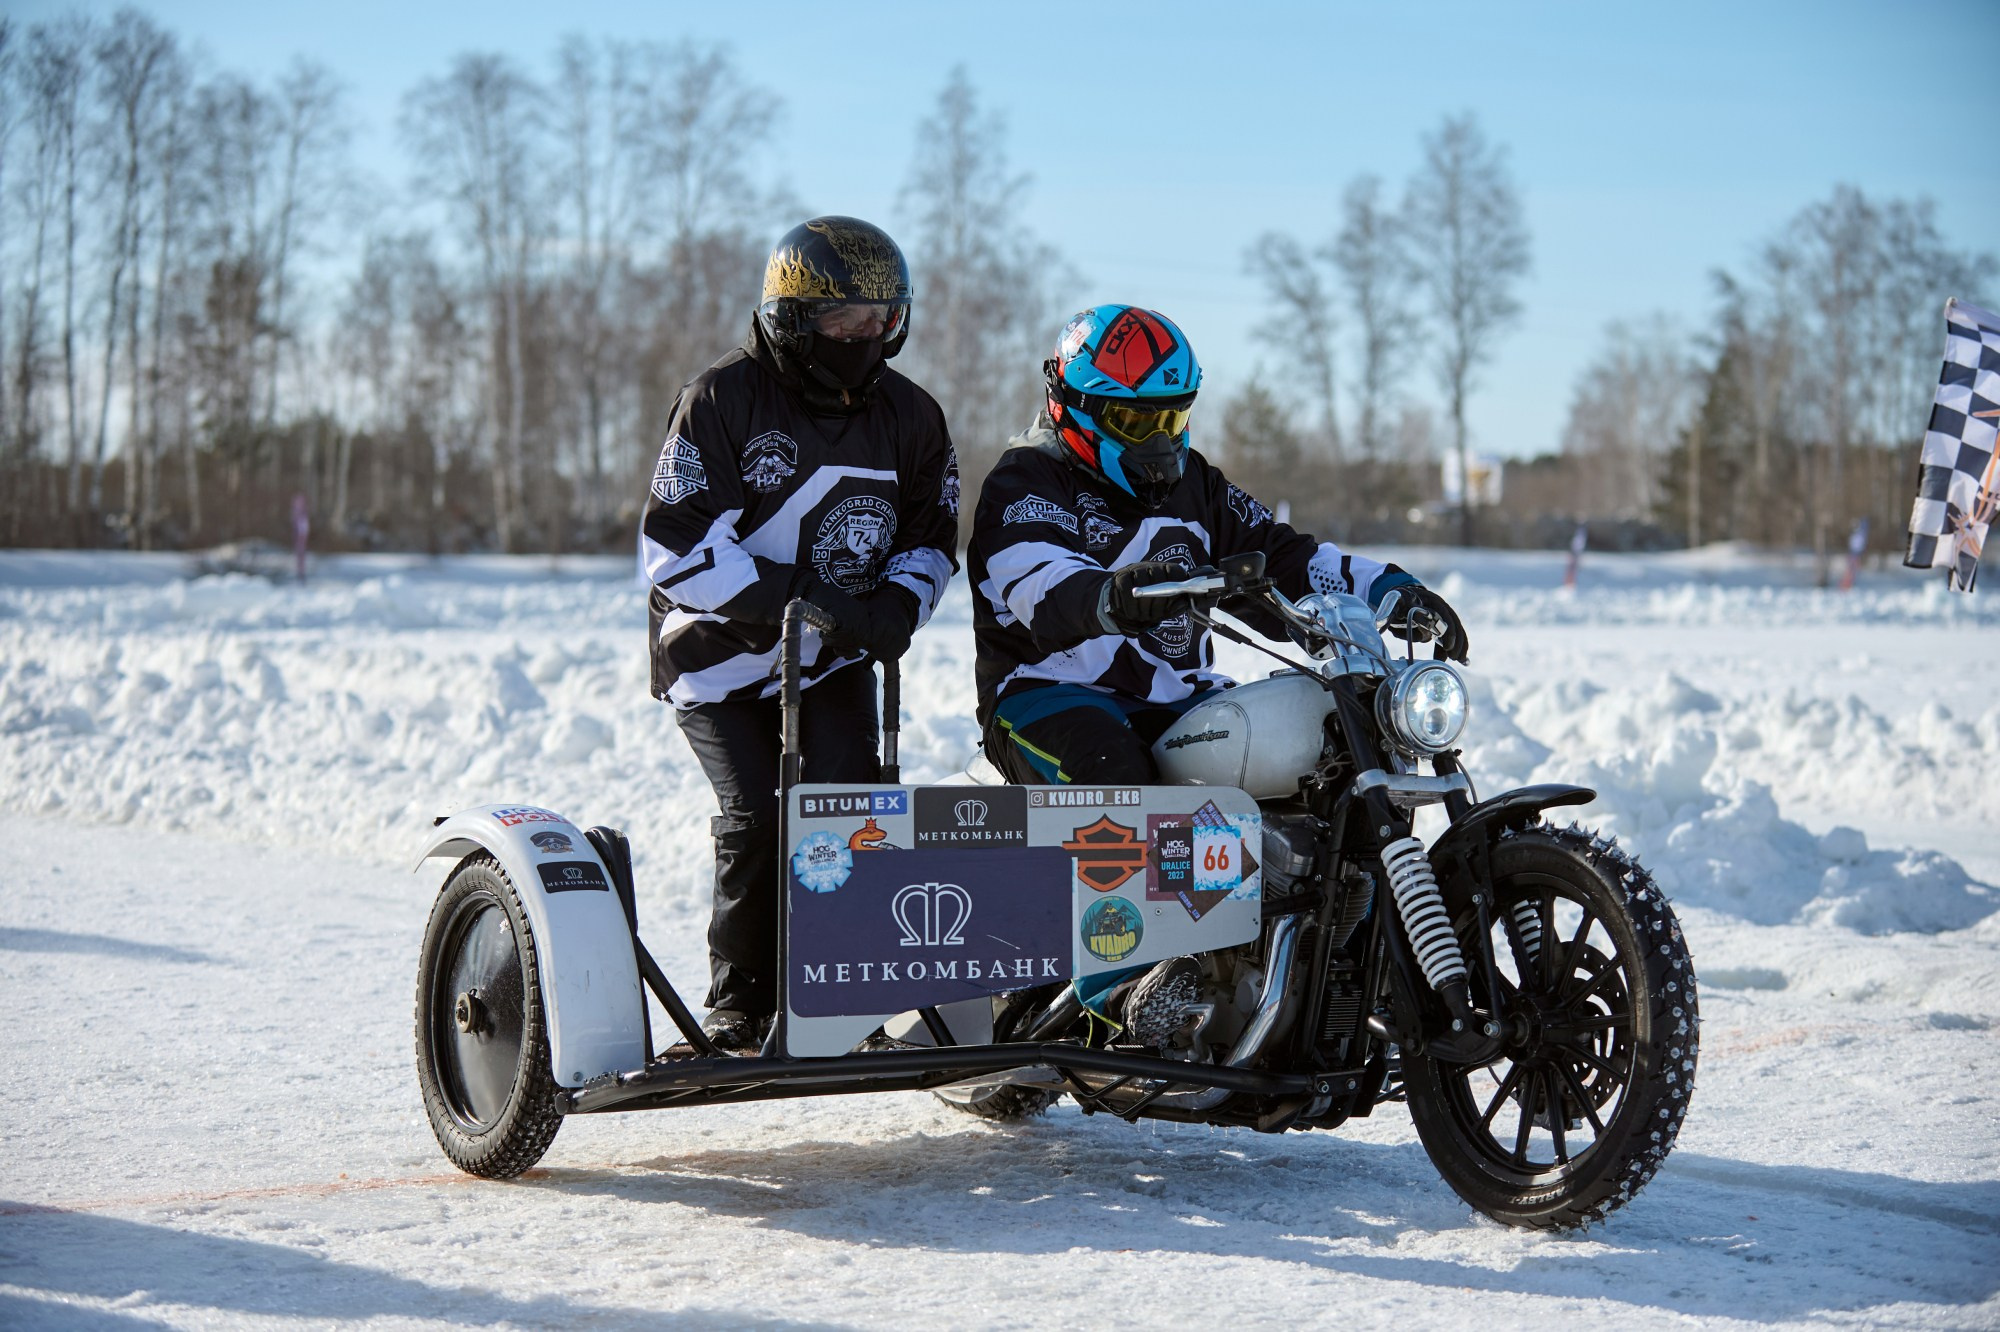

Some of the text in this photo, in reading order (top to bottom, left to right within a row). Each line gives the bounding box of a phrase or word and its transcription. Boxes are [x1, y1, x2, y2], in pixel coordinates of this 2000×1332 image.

[1106, 317, 1137, 355] CKX
[821, 499, 874, 533] TANKOGRAD
[815, 550, 828, 559] 20
[1049, 790, 1140, 806] KVADRO_EKB
[805, 796, 900, 813] BITUMEX
[918, 830, 1024, 841] МЕТКОМБАНК
[813, 845, 831, 853] HOG
[1166, 840, 1185, 848] HOG
[808, 850, 837, 861] WINTER
[1161, 846, 1190, 857] WINTER
[1203, 845, 1230, 871] 66
[1161, 861, 1191, 871] URALICE
[1167, 871, 1185, 880] 2023
[1090, 930, 1136, 956] KVADRO
[803, 957, 1060, 984] МЕТКОМБАНК
